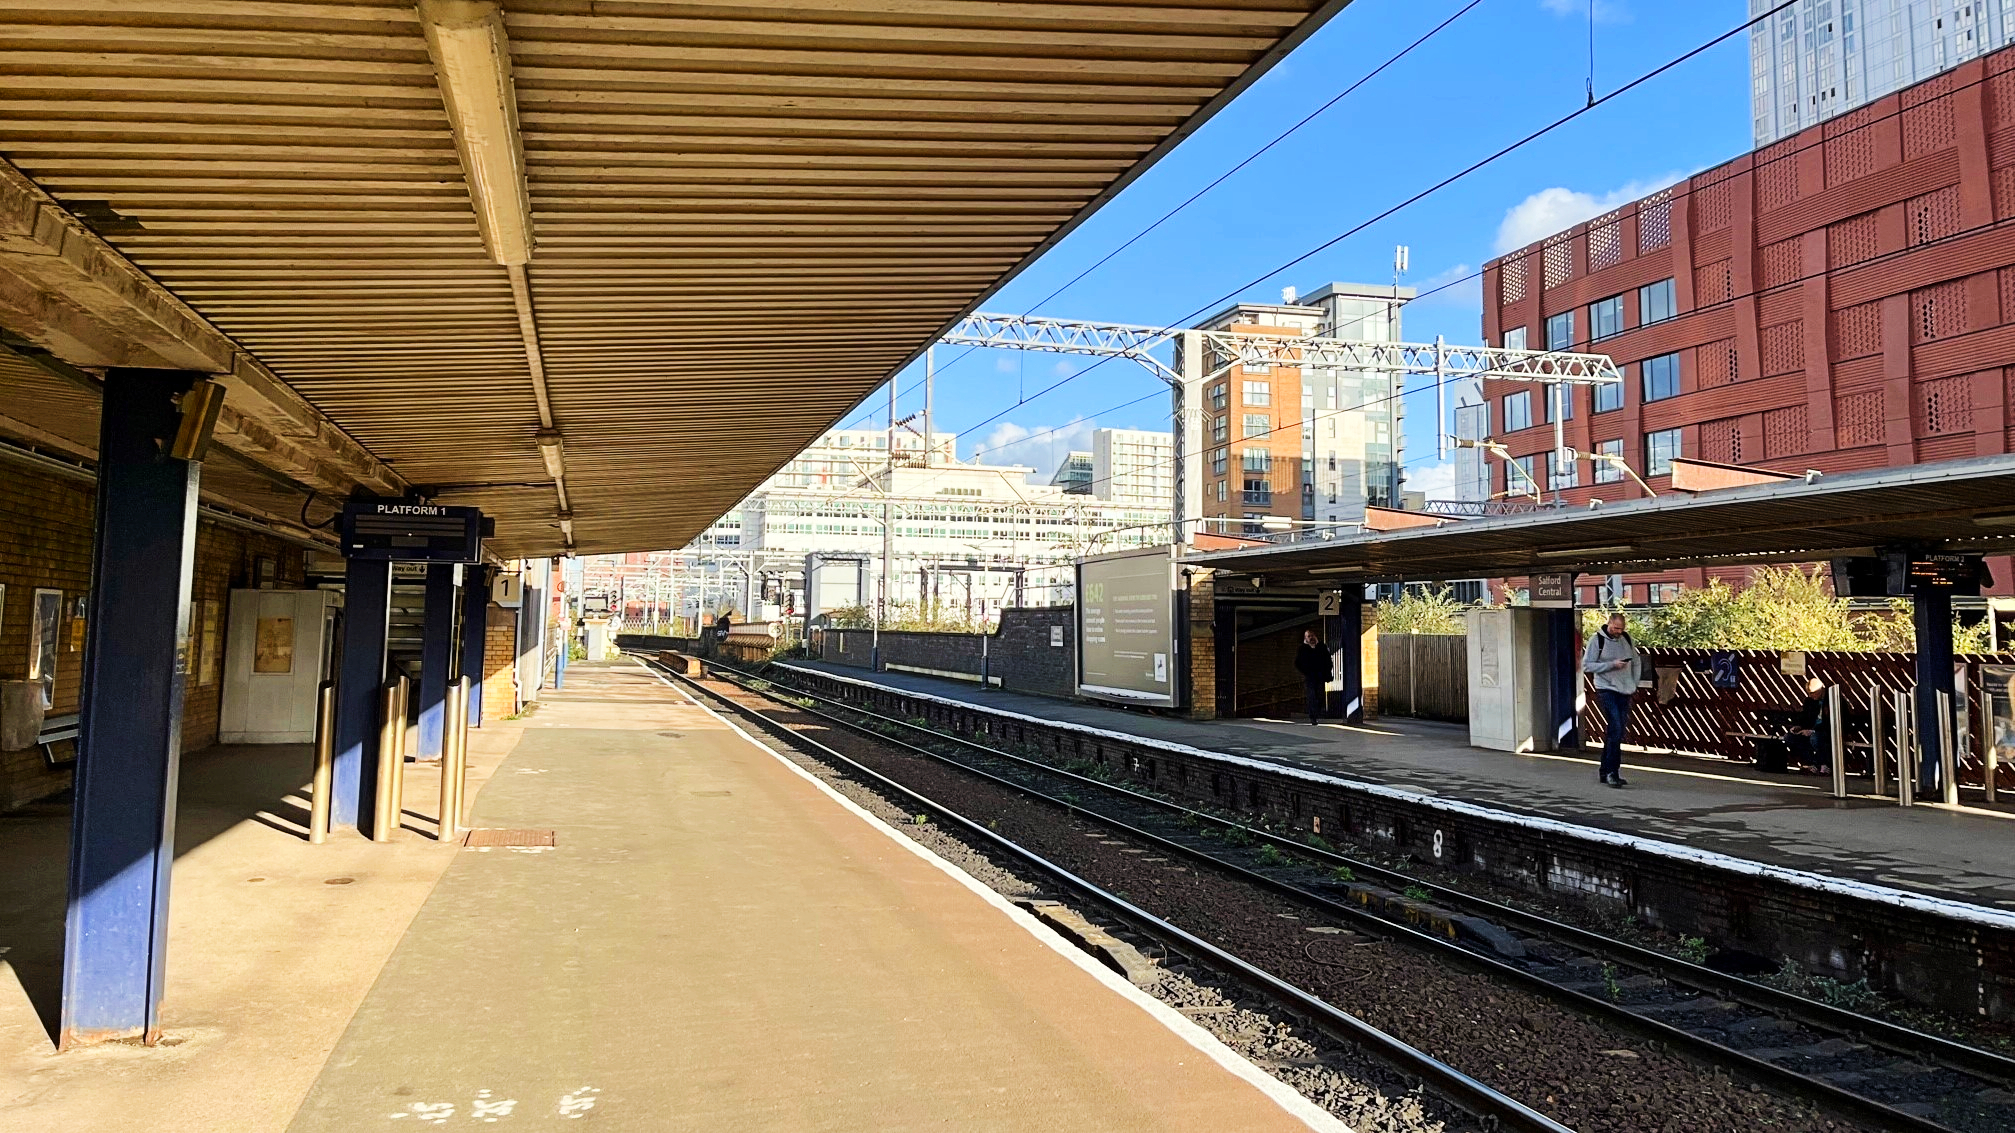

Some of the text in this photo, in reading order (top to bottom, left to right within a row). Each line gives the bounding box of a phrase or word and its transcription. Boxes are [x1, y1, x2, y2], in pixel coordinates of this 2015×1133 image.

[377, 504, 446, 516] PLATFORM 1
[1925, 554, 1960, 562] PLATFORM
[1538, 576, 1561, 585] Salford
[501, 579, 508, 597] 1
[1538, 587, 1562, 596] Central
[1324, 595, 1334, 611] 2
[1132, 757, 1140, 772] 7
[1433, 829, 1443, 858] 8
